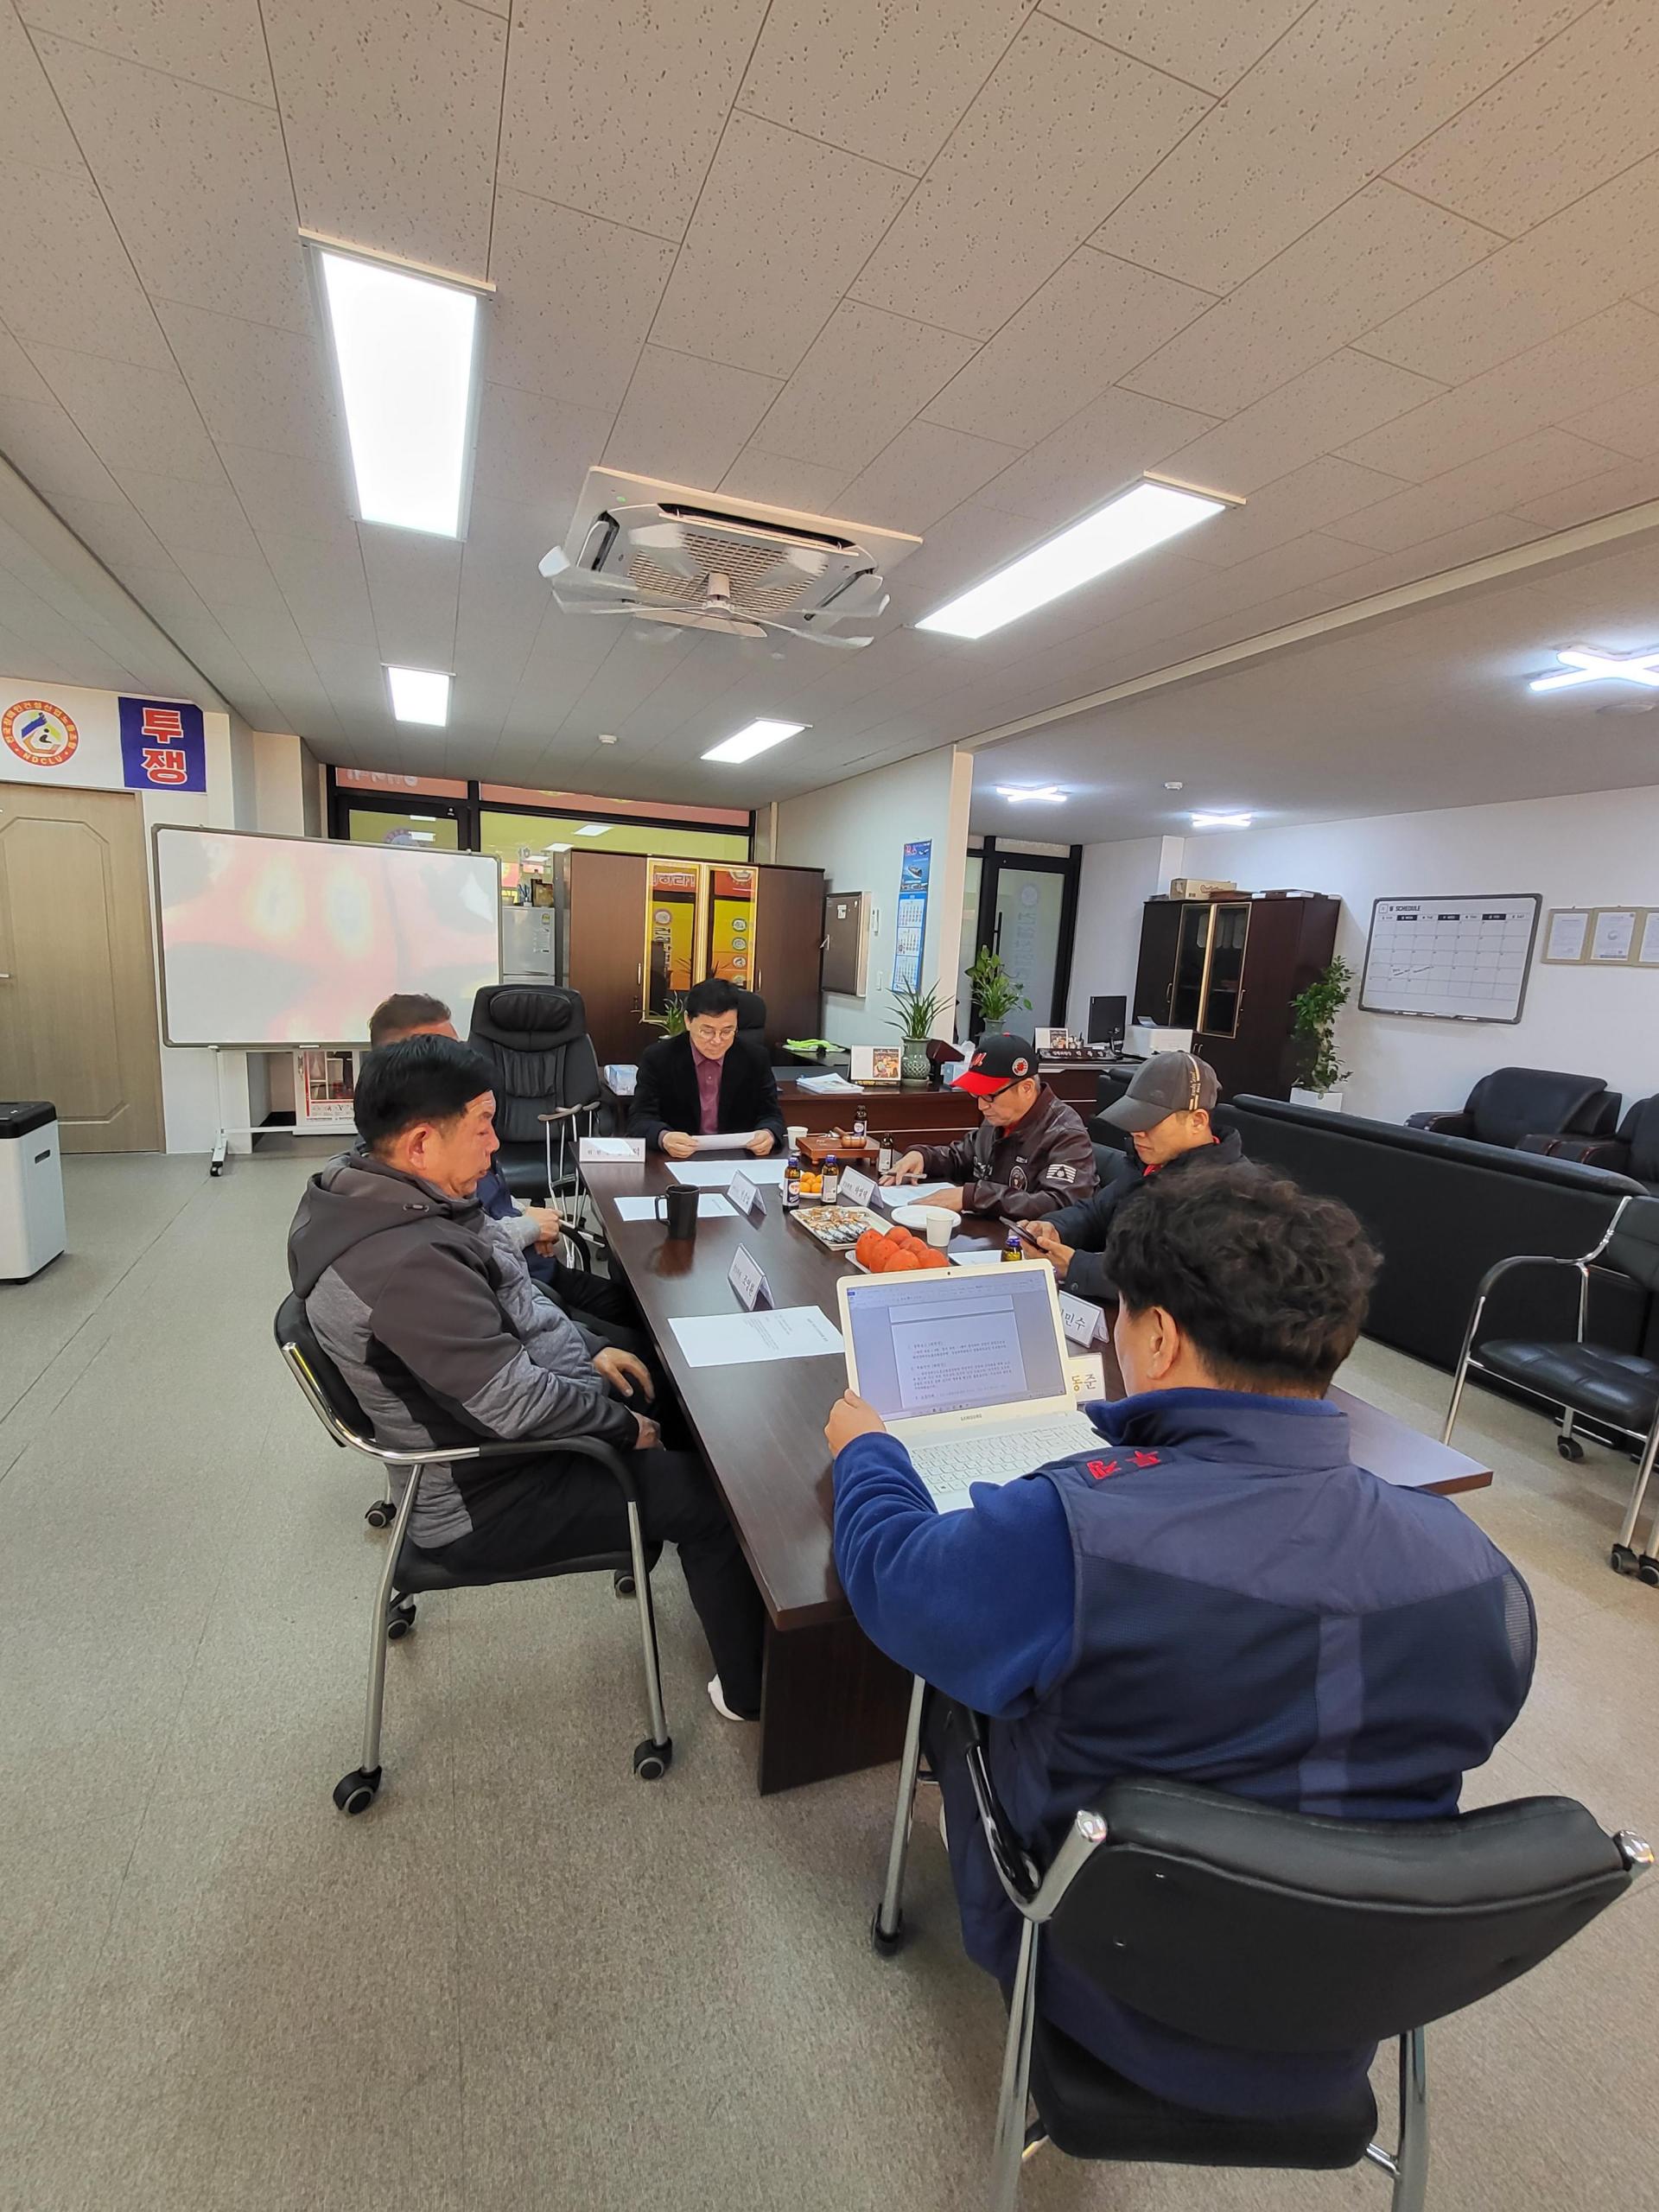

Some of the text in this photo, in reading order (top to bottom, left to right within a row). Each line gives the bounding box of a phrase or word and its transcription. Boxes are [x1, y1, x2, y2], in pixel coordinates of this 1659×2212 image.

[141, 707, 188, 785] 투쟁
[22, 753, 62, 765] NDCLU
[1060, 1309, 1085, 1331] 민수
[1071, 1374, 1096, 1391] 동준
